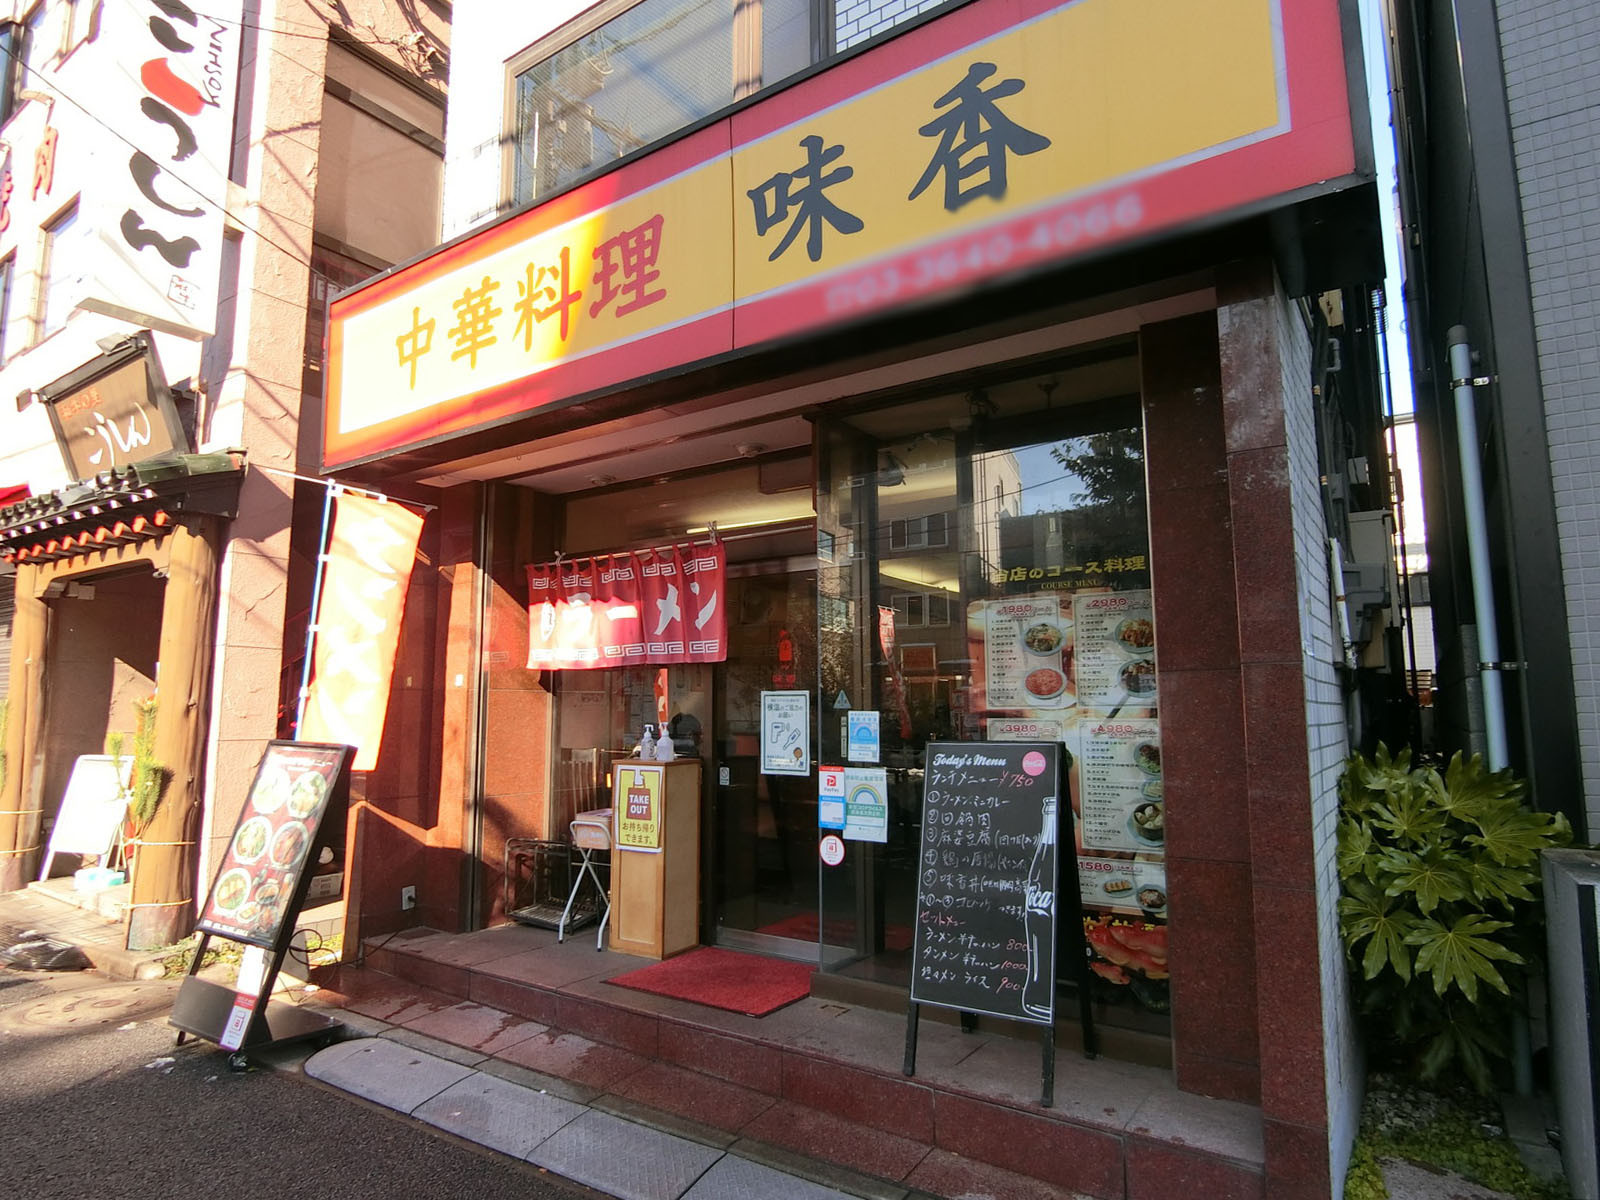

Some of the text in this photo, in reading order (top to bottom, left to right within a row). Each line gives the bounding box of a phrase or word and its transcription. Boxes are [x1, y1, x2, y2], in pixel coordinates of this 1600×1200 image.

[197, 14, 228, 108] KOSHIN
[395, 62, 1052, 391] 中華料理 味香
[932, 753, 972, 769] Today's
[973, 754, 1007, 766] Menu
[628, 794, 650, 805] TAKE
[630, 805, 648, 815] OUT
[622, 821, 655, 833] お持ち帰り
